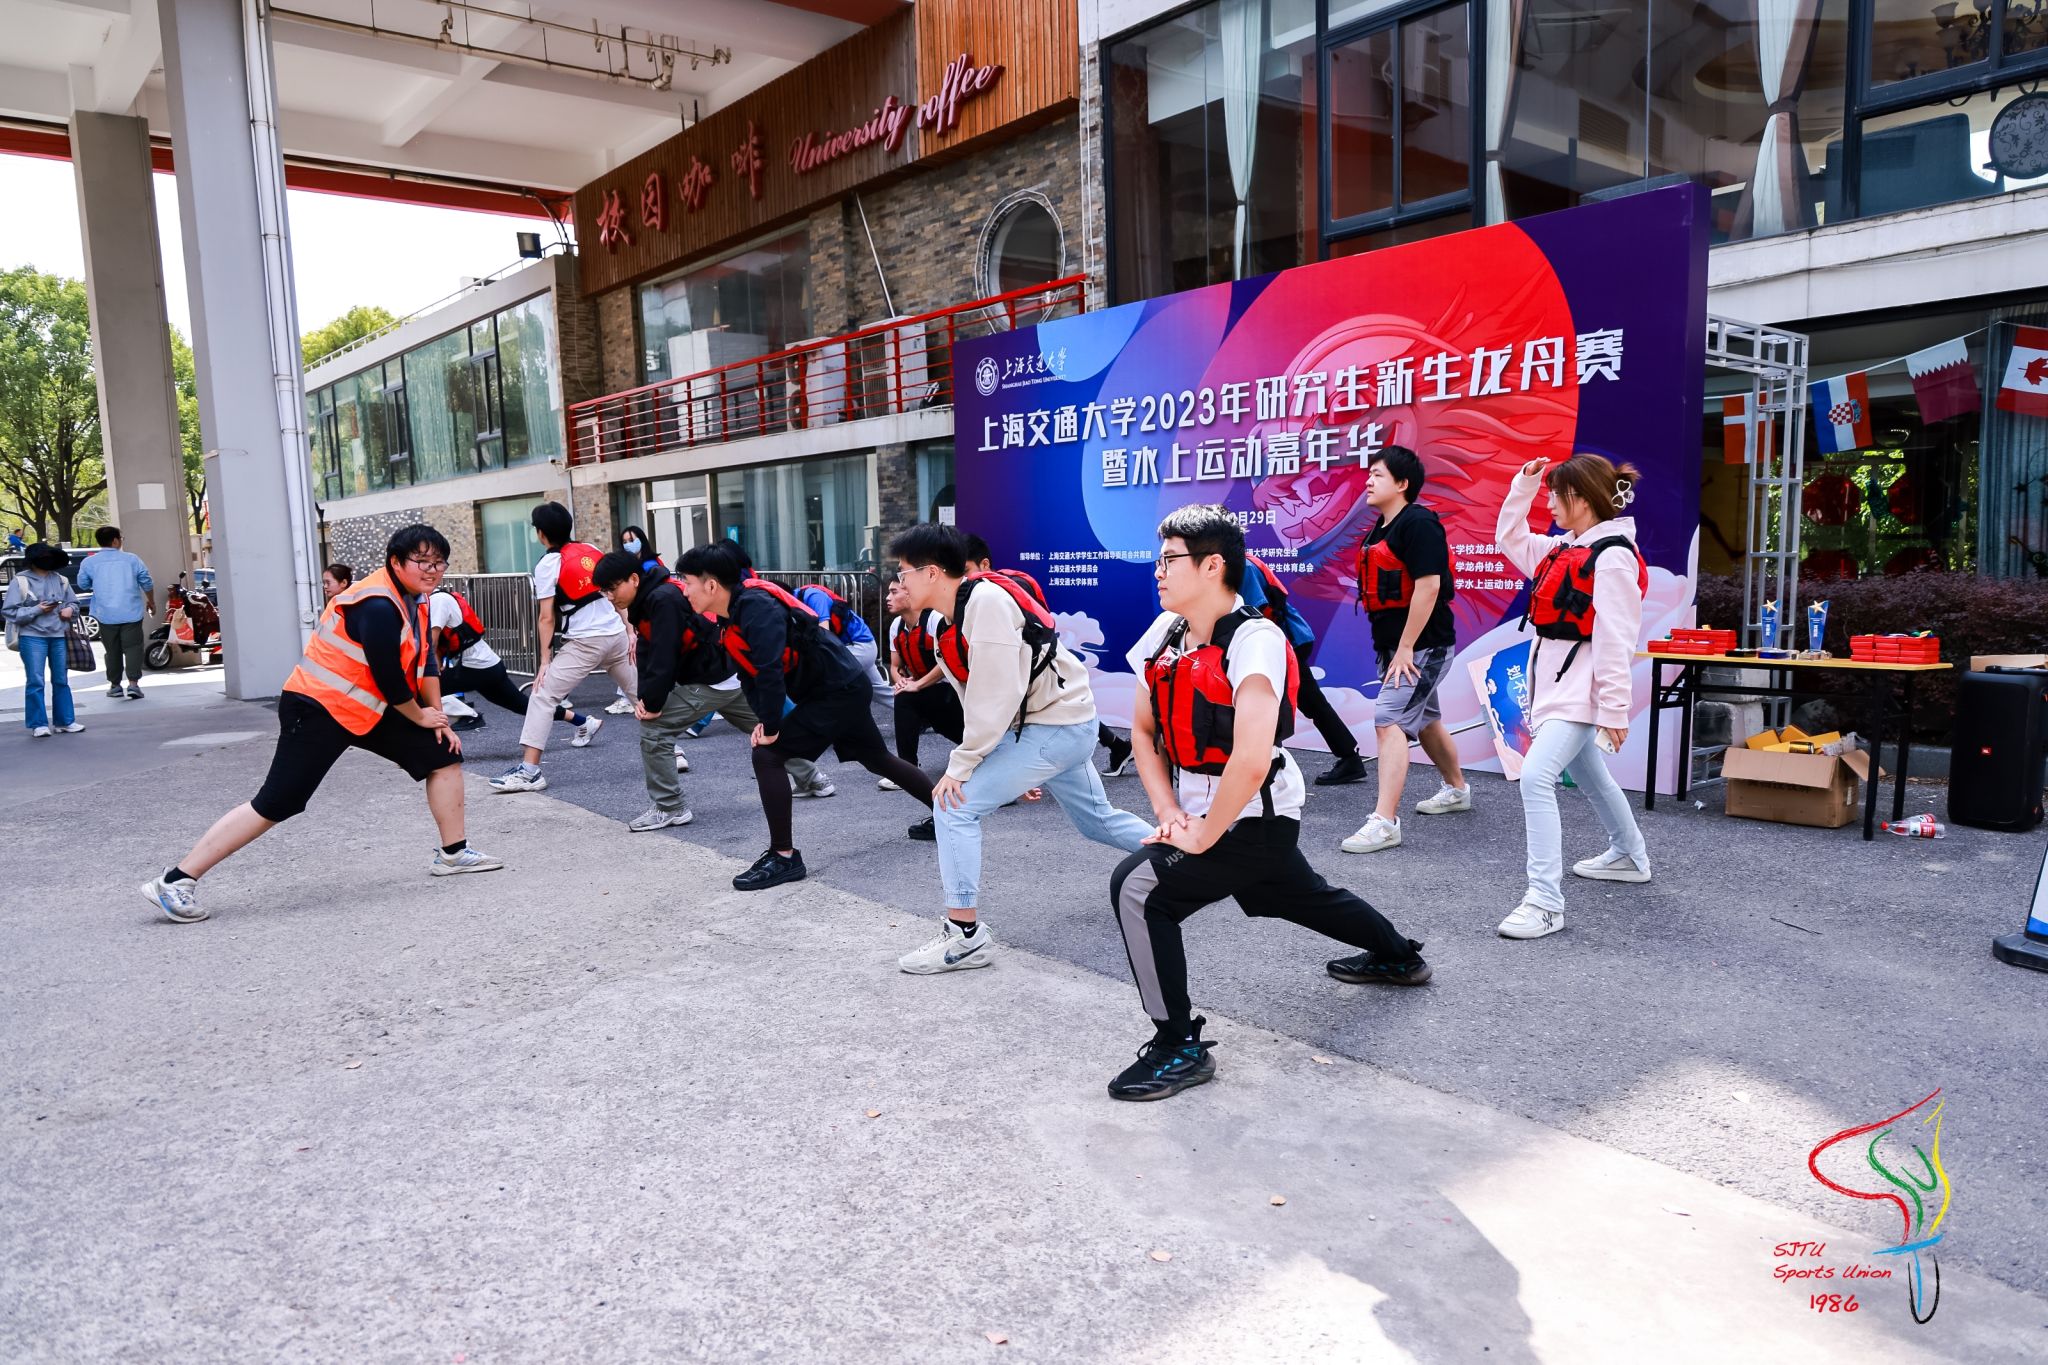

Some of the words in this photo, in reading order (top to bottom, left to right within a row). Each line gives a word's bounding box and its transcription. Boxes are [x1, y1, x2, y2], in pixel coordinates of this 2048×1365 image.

[789, 95, 916, 174] University
[917, 53, 1005, 136] coffee
[978, 327, 1623, 452] 上海交通大学2023年研究生新生龙舟赛
[1102, 423, 1384, 488] 暨水上运动嘉年华
[1265, 562, 1314, 573] 学生体育总会
[1164, 850, 1186, 867] JUS
